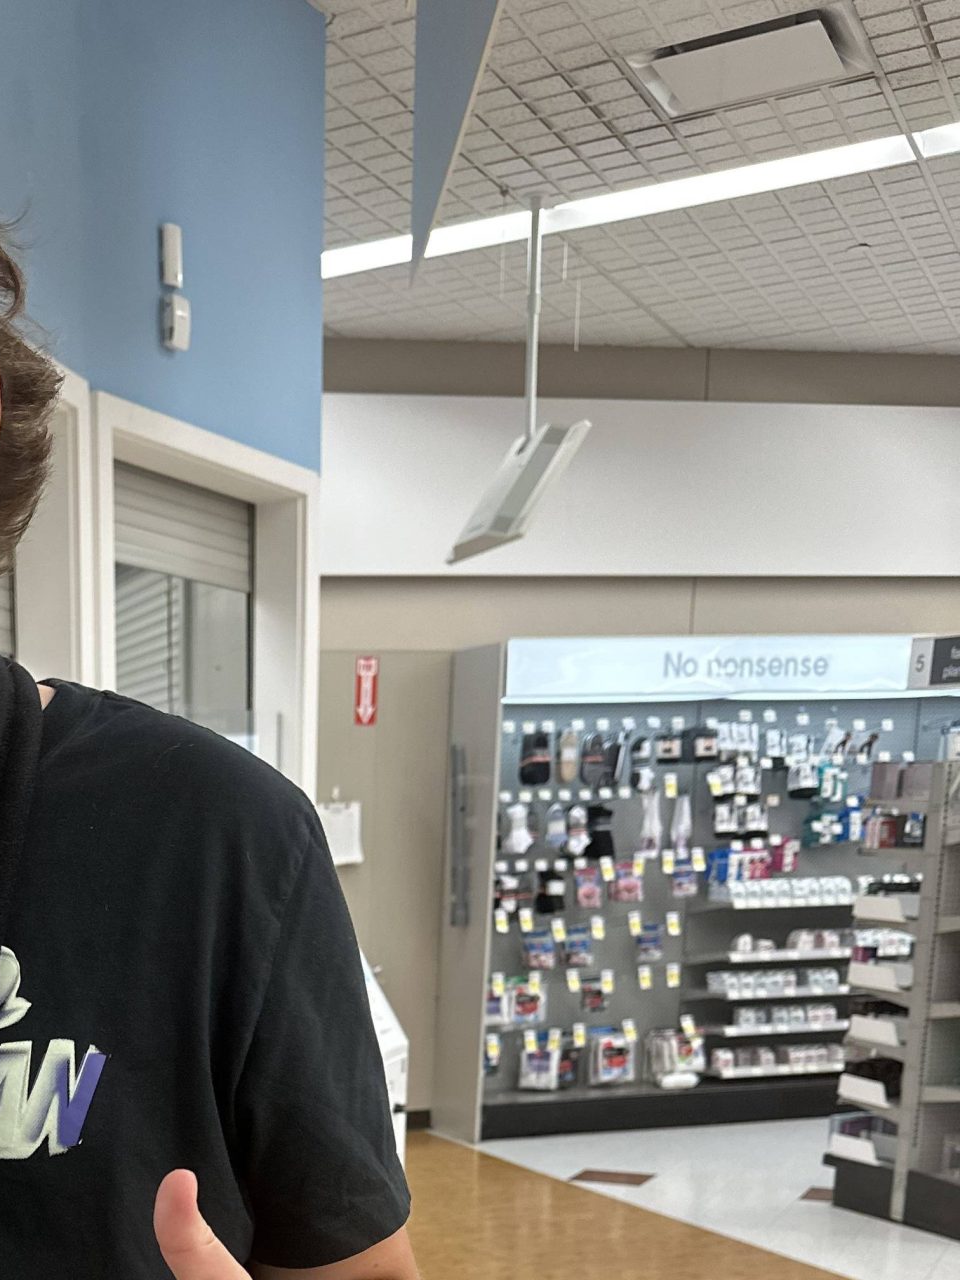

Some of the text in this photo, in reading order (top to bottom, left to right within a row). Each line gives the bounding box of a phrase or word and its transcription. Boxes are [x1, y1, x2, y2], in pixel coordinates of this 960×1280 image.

[663, 652, 829, 678] No nonsense
[914, 653, 926, 673] 5
